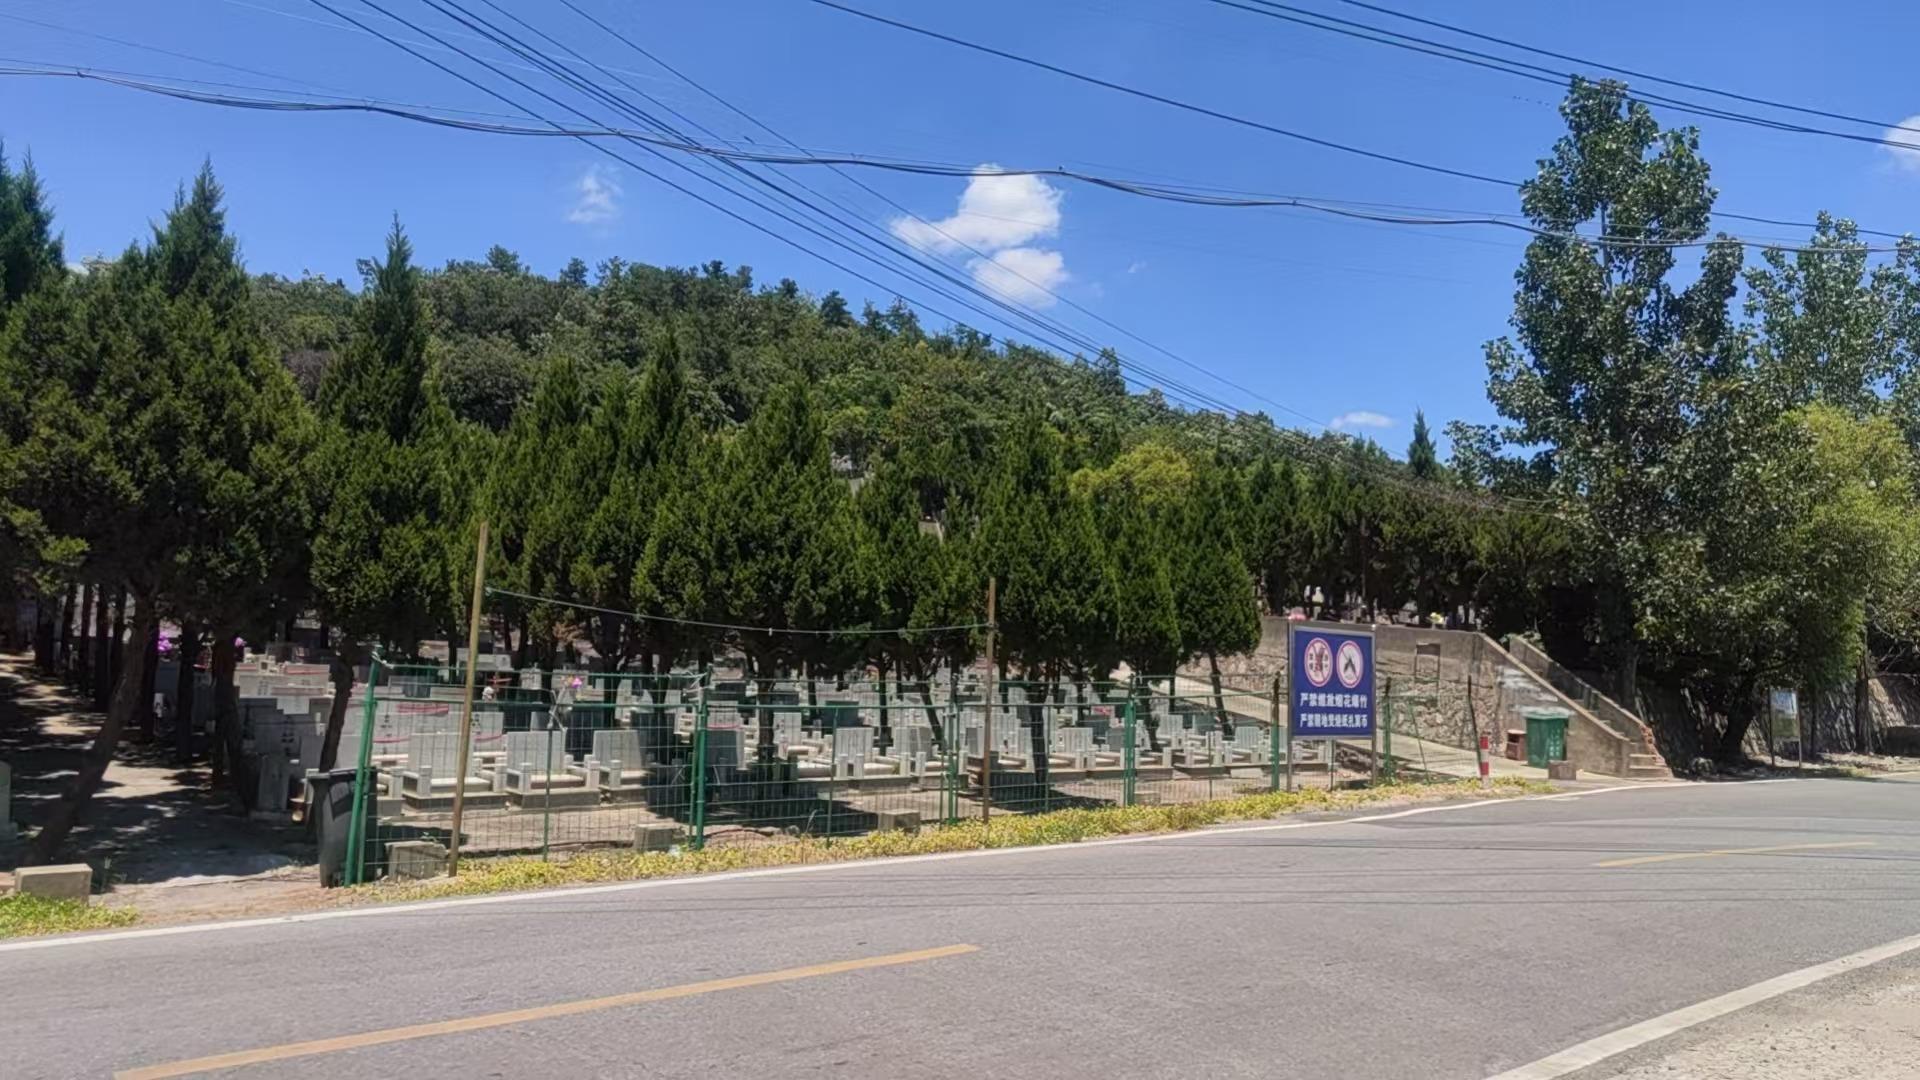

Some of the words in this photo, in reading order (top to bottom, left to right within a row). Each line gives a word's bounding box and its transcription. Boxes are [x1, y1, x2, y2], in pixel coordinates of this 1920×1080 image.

[1300, 692, 1367, 708] 严禁燃放烟花爆竹
